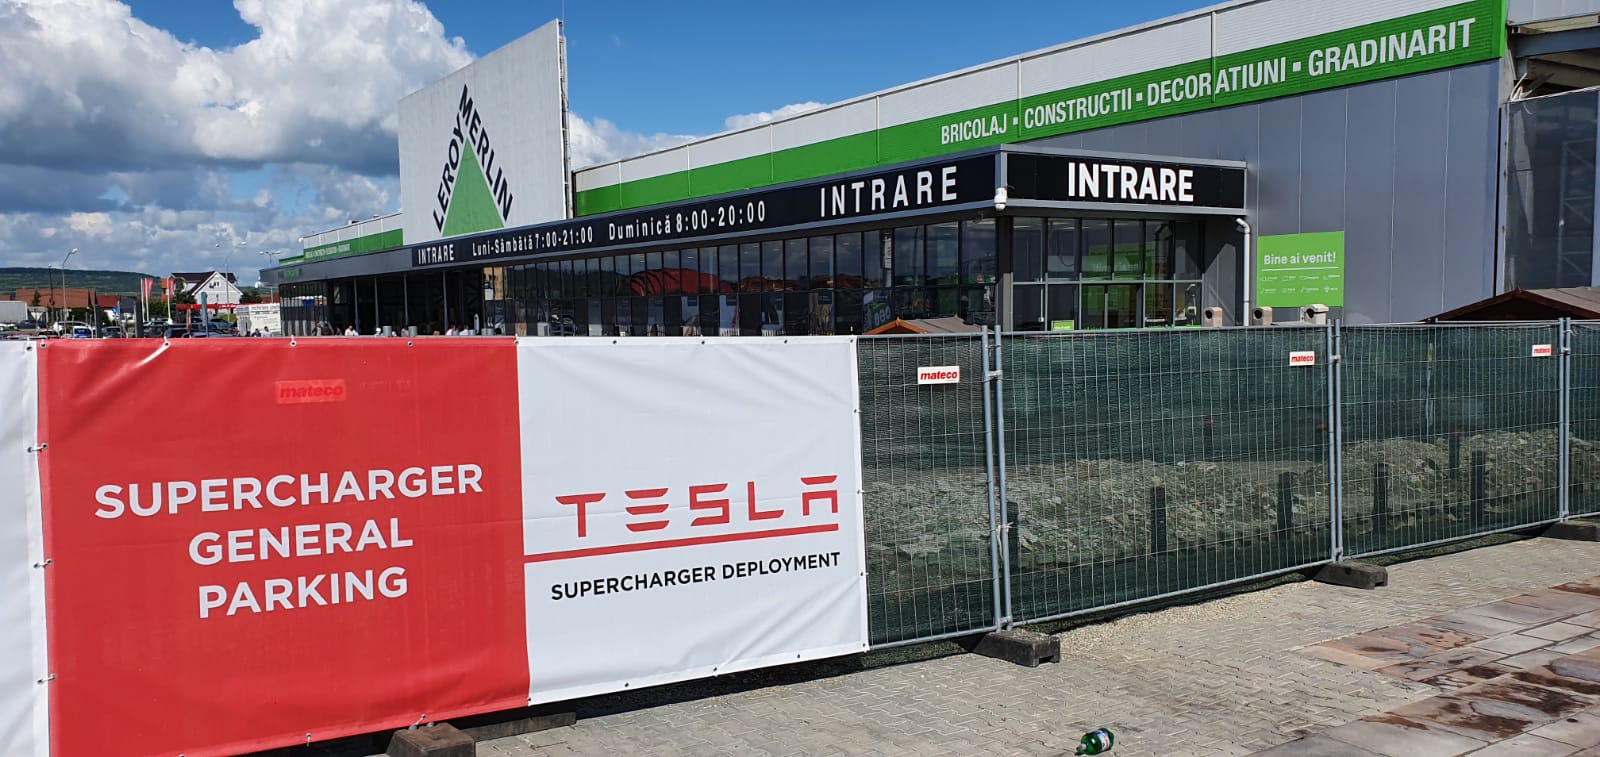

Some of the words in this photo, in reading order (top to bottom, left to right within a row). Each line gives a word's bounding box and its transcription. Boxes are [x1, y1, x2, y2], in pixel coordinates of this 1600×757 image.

[941, 113, 1007, 145] BRICOLAJ
[1024, 87, 1132, 129] CONSTRUCTII
[1147, 56, 1286, 106] DECORATIUNI
[1308, 18, 1476, 77] GRADINARIT
[432, 113, 465, 233] LEROY
[459, 83, 514, 221] MERLIN
[820, 165, 958, 217] INTRARE
[1068, 162, 1194, 202] INTRARE
[535, 226, 593, 249] 7:00-21:00
[608, 214, 671, 241] Duminică
[676, 200, 765, 233] 8:00-20:00
[418, 244, 455, 265] INTRARE
[1263, 254, 1288, 265] Bine
[1290, 252, 1300, 264] ai
[1302, 251, 1336, 264] venit!
[279, 384, 344, 399] mateco
[920, 370, 958, 381] mateco
[95, 463, 483, 519] SUPERCHARGER
[555, 475, 839, 538] TESLA
[189, 517, 413, 566] GENERAL
[199, 566, 408, 619] PARKING
[551, 566, 716, 601] SUPERCHARGER
[722, 552, 841, 580] DEPLOYMENT
